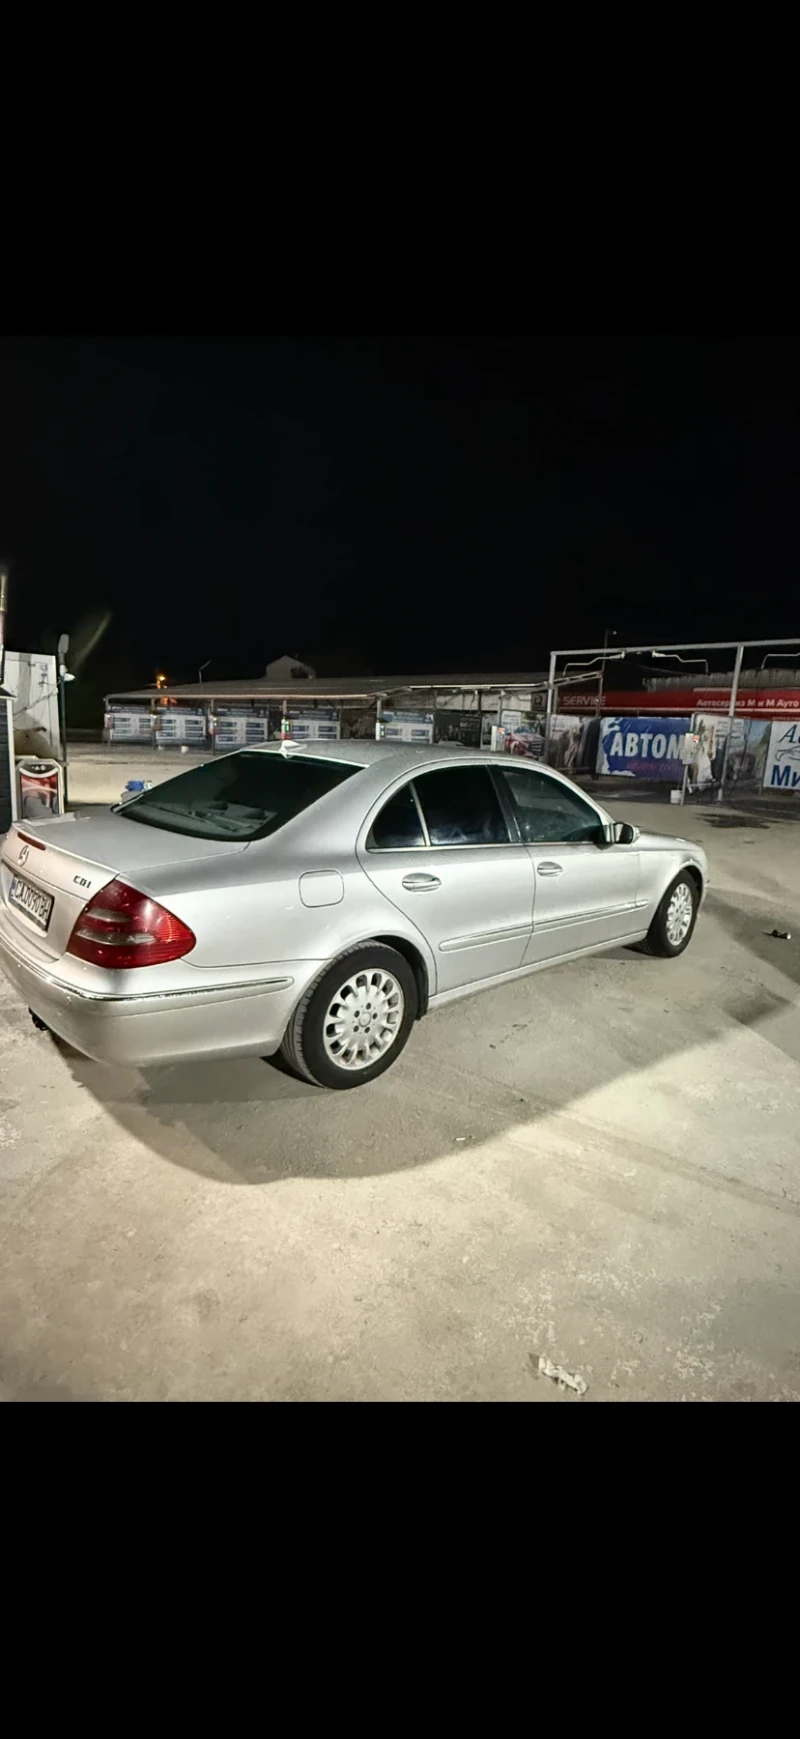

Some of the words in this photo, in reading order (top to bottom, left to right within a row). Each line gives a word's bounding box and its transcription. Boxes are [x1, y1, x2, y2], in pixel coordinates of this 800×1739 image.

[563, 695, 606, 706] SERVICE
[696, 699, 745, 708] Автосериз
[73, 875, 92, 889] CDI
